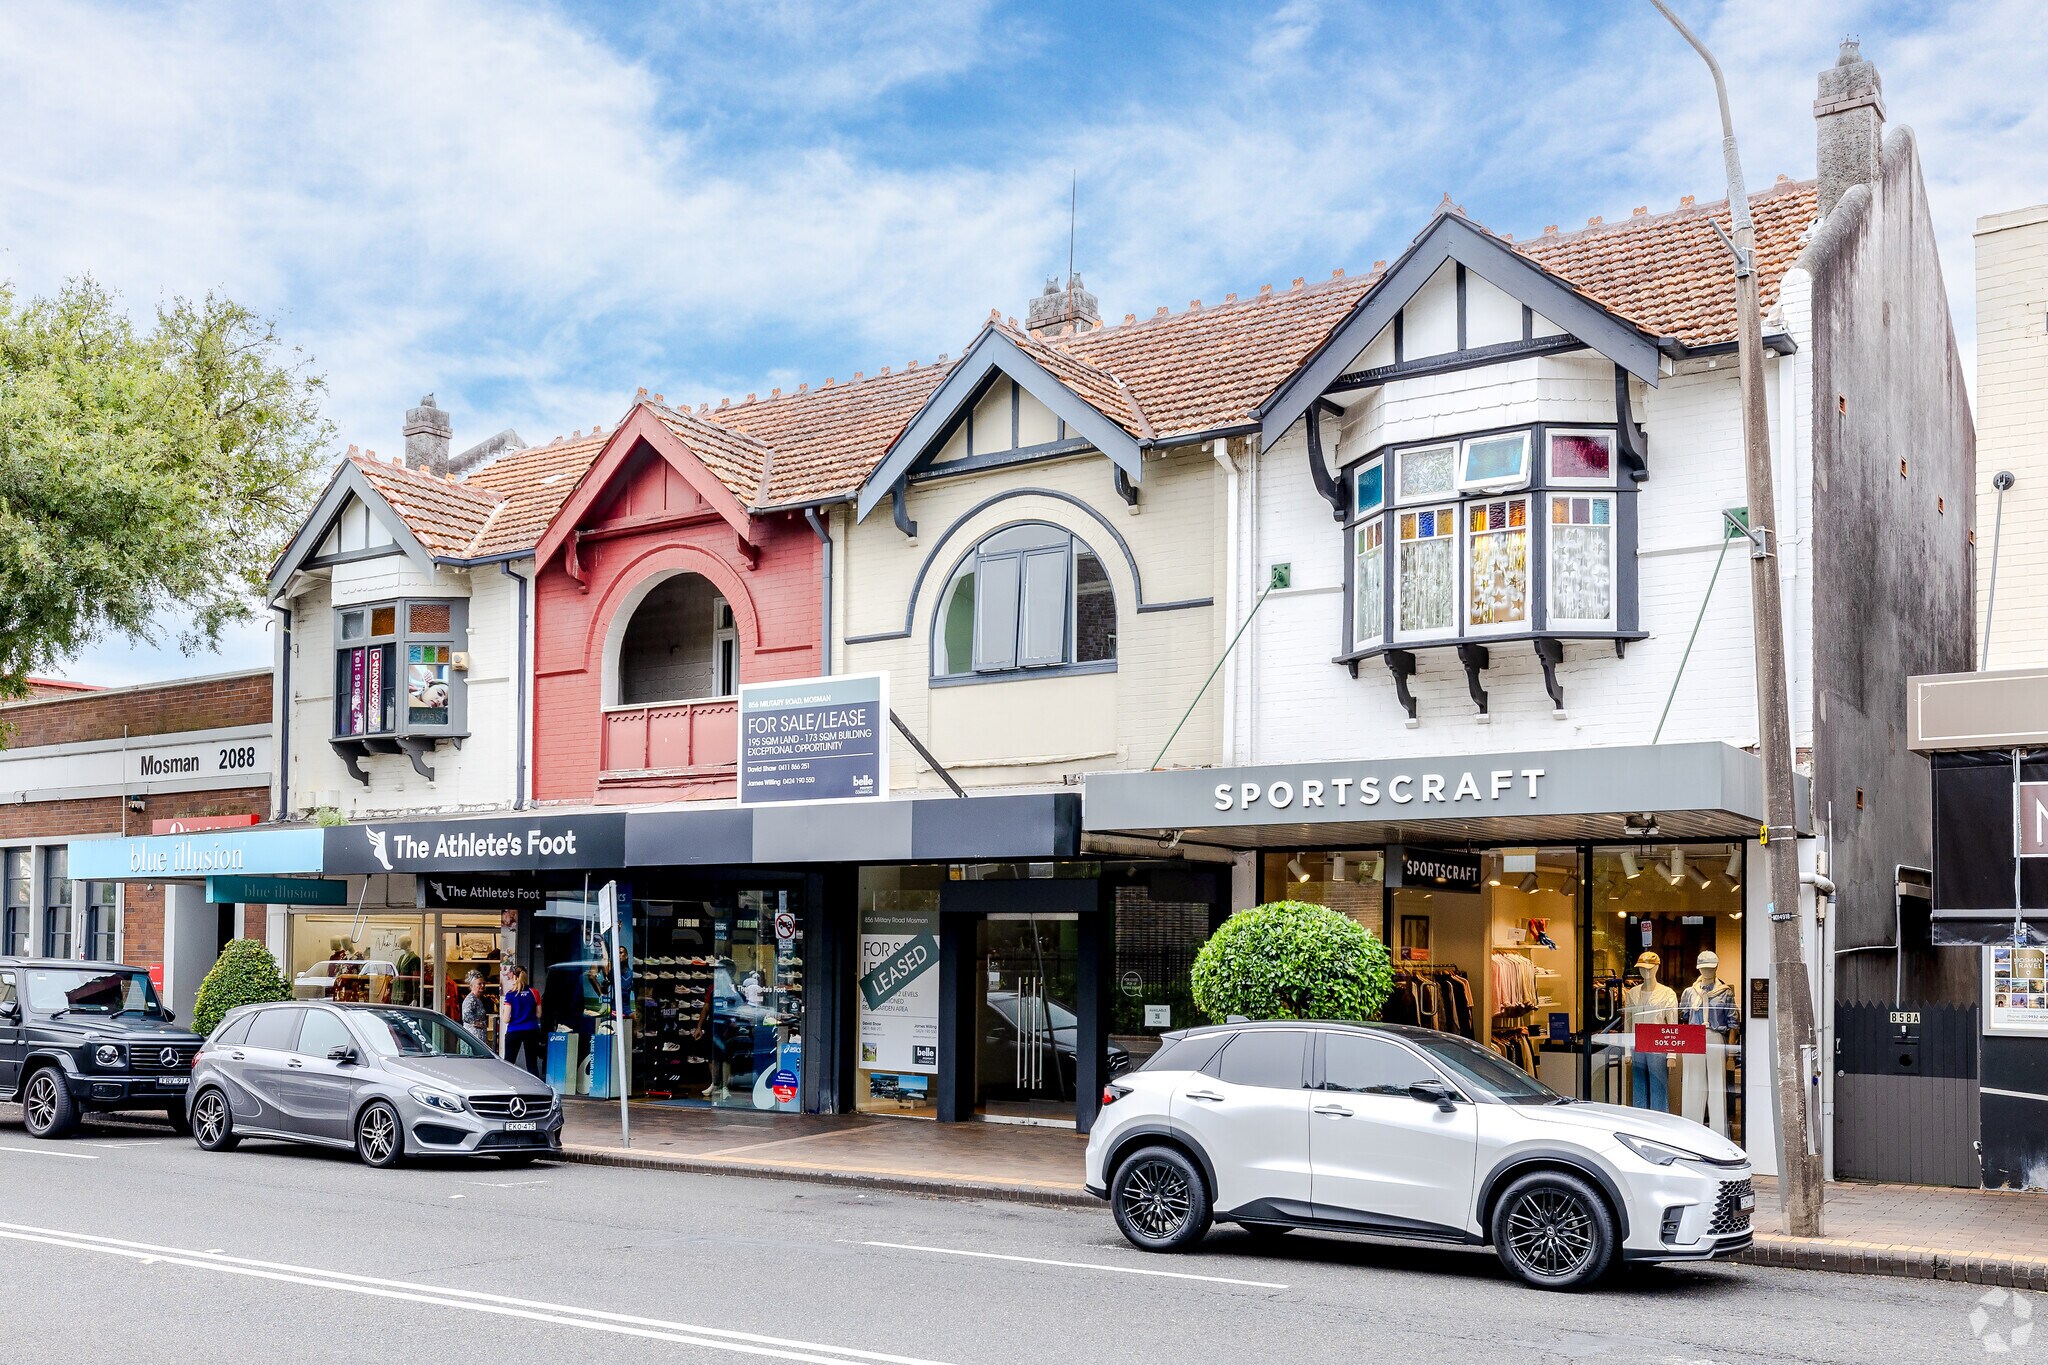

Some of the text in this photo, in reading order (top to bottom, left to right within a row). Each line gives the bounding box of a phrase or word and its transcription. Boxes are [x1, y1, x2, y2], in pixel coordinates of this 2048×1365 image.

[748, 701, 759, 709] 856
[760, 699, 784, 707] MILITARY
[804, 694, 831, 704] MOSMAN
[748, 709, 866, 734] FOR SALE/LEASE
[748, 738, 760, 747] 195
[761, 736, 779, 746] SQM
[780, 734, 800, 744] LAND
[805, 733, 817, 742] 173
[819, 731, 837, 741] SQM
[838, 729, 872, 740] BUILDING
[748, 741, 843, 756] EXCEPTIONAL OPPORTUNITY
[141, 747, 255, 776] Mosman 2088
[764, 779, 781, 787] Willing
[853, 775, 874, 787] belle
[1214, 769, 1546, 811] SPORTSCRAFT
[393, 830, 577, 859] The Athlete's Foot
[130, 842, 244, 872] blue illusion
[1407, 860, 1478, 882] SPORTSCRAFT
[244, 884, 318, 899] blue illusion
[447, 886, 540, 900] The Athlete's Foot
[863, 942, 890, 957] FOR
[872, 945, 927, 996] LEASED
[894, 1005, 909, 1013] AREA
[1891, 1012, 1919, 1023] 858A
[917, 1047, 935, 1057] belle
